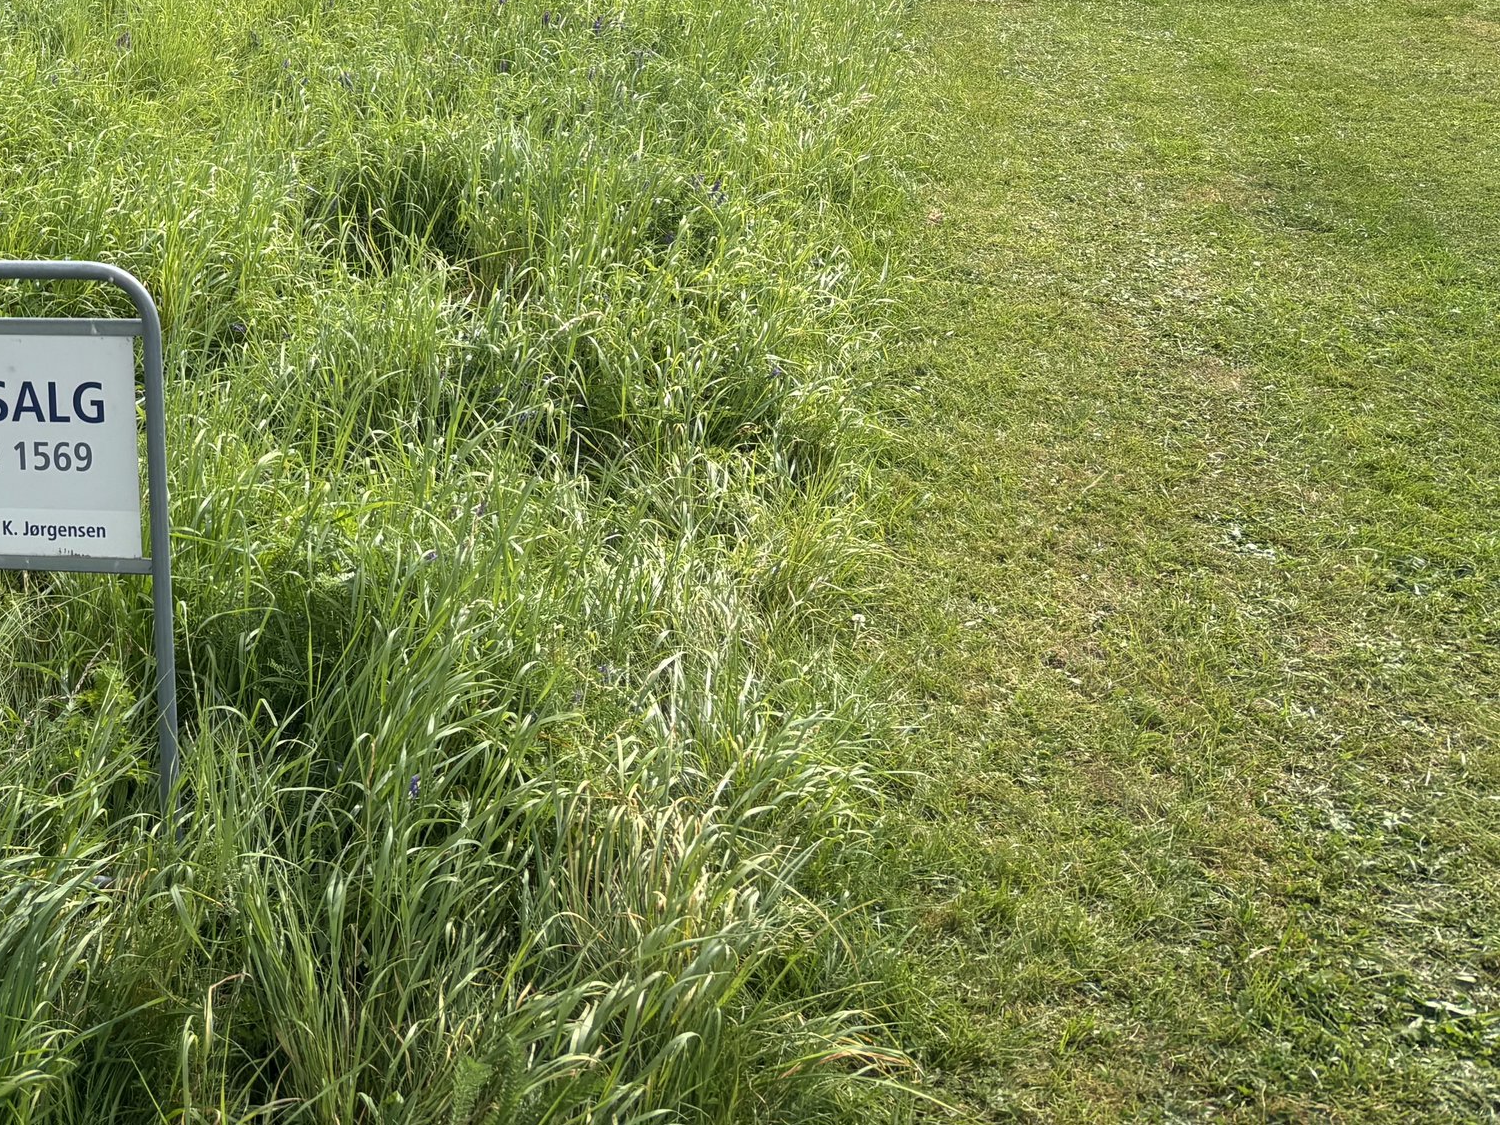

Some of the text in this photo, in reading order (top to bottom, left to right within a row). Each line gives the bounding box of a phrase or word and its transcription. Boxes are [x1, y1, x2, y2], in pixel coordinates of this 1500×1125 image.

[13, 441, 93, 472] 1569
[2, 520, 18, 536] K.
[22, 520, 106, 541] Jørgensen
